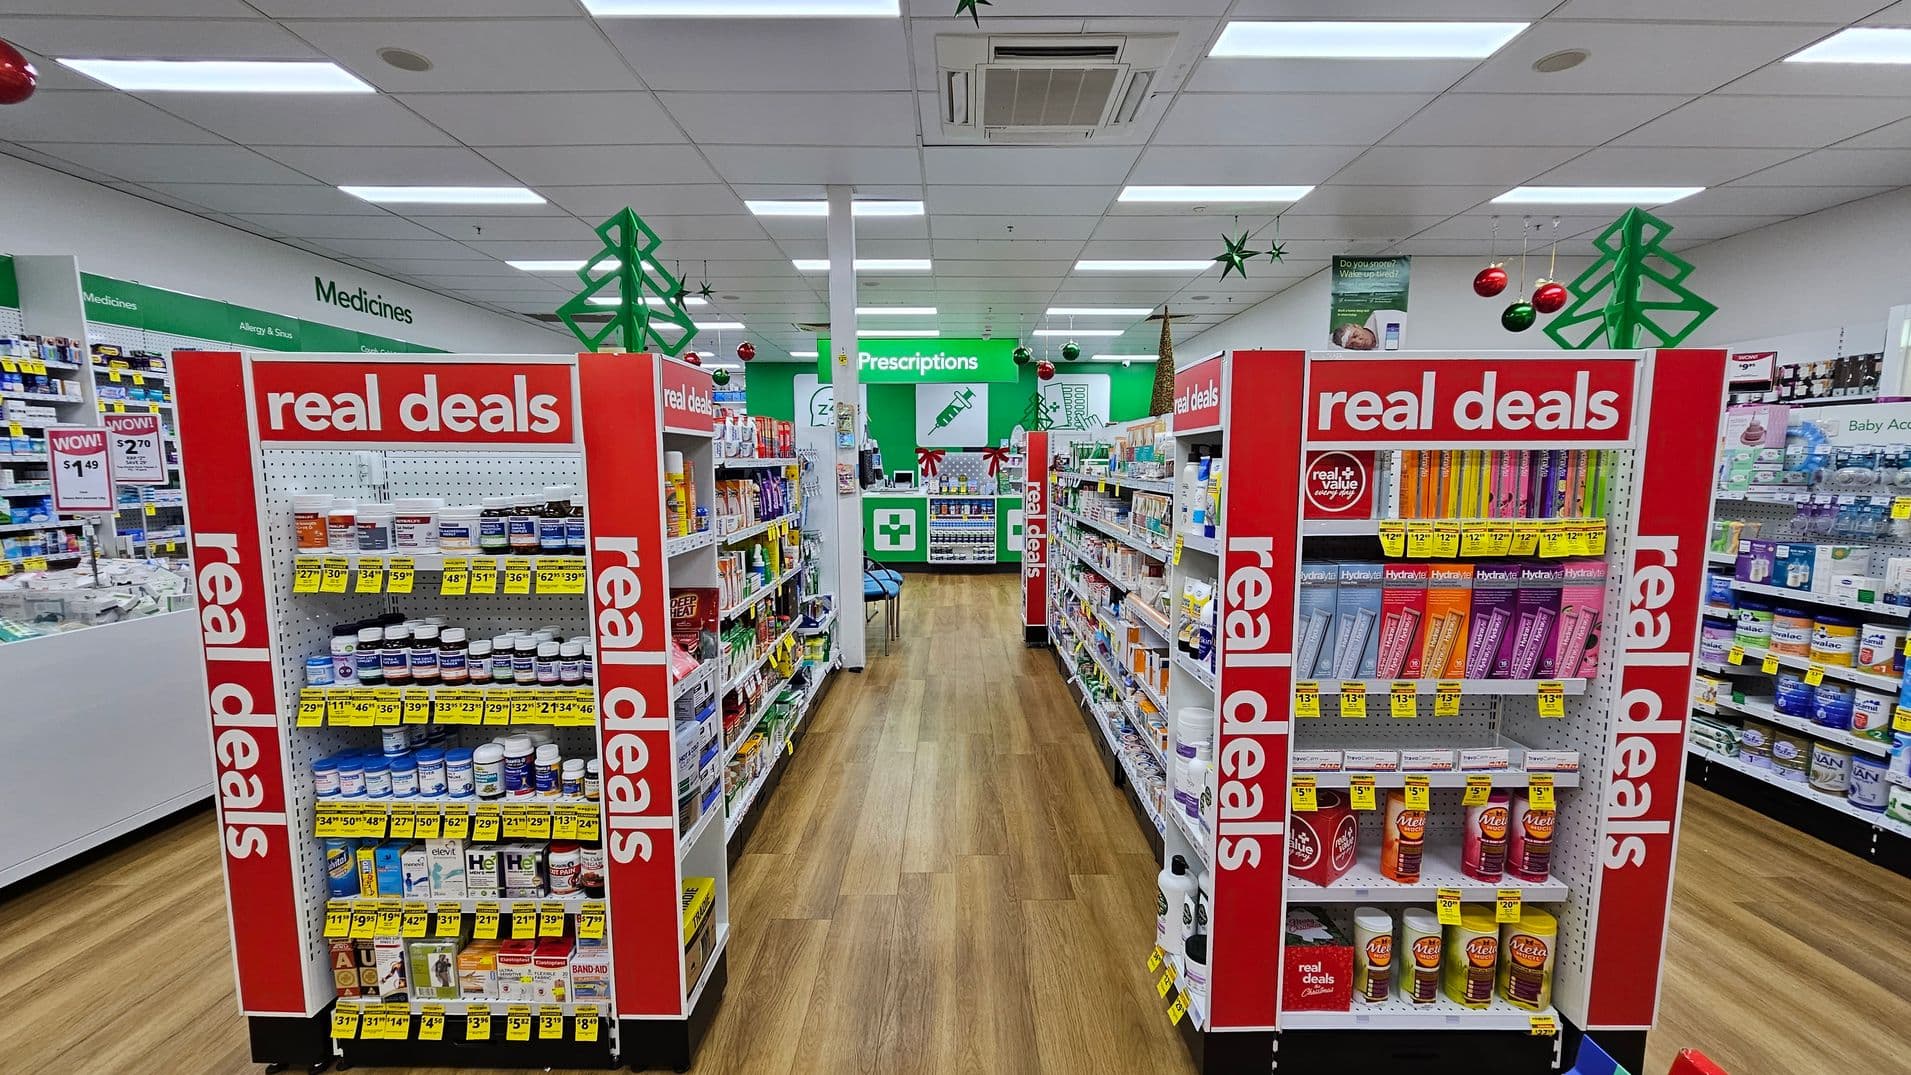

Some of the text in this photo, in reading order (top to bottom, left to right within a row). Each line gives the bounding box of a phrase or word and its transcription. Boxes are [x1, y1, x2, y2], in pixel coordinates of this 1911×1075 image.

[1354, 261, 1368, 270] you
[1370, 260, 1396, 268] snore?
[1376, 270, 1398, 278] tired?
[83, 291, 137, 311] Medicines
[314, 276, 413, 324] Medicines
[239, 321, 293, 339] Allergy & Sinus
[858, 352, 978, 376] Prescriptions
[267, 373, 560, 433] real deals
[664, 384, 712, 416] real deals
[1174, 380, 1218, 415] real deals
[1318, 370, 1619, 431] real deals
[107, 416, 154, 432] WOW!
[1849, 419, 1883, 433] Baby
[53, 433, 102, 451] WOW!
[1312, 467, 1338, 481] real
[1322, 477, 1358, 490] value
[1314, 489, 1355, 500] every day
[1027, 482, 1046, 578] real deals
[1342, 570, 1382, 580] Hydralyte
[1386, 570, 1426, 580] Hydralyte
[1432, 570, 1472, 580] Hydralyte
[1476, 570, 1518, 580] Hydralyte
[1522, 570, 1563, 580] Hydralyte
[1564, 568, 1606, 578] Hydralyte
[671, 595, 697, 608] DEEP
[671, 605, 695, 618] HEAT
[1773, 632, 1802, 641] ovalac
[1812, 640, 1842, 650] ovalac
[194, 532, 287, 859] real deals
[595, 537, 672, 864] real deals
[1218, 537, 1292, 871] real deals
[1603, 536, 1690, 870] real deals
[1814, 752, 1843, 768] NAN
[432, 848, 456, 856] elevit
[1510, 940, 1548, 957] Meta
[572, 965, 608, 974] BAND-AID
[1299, 962, 1321, 973] real
[1302, 973, 1335, 984] deals
